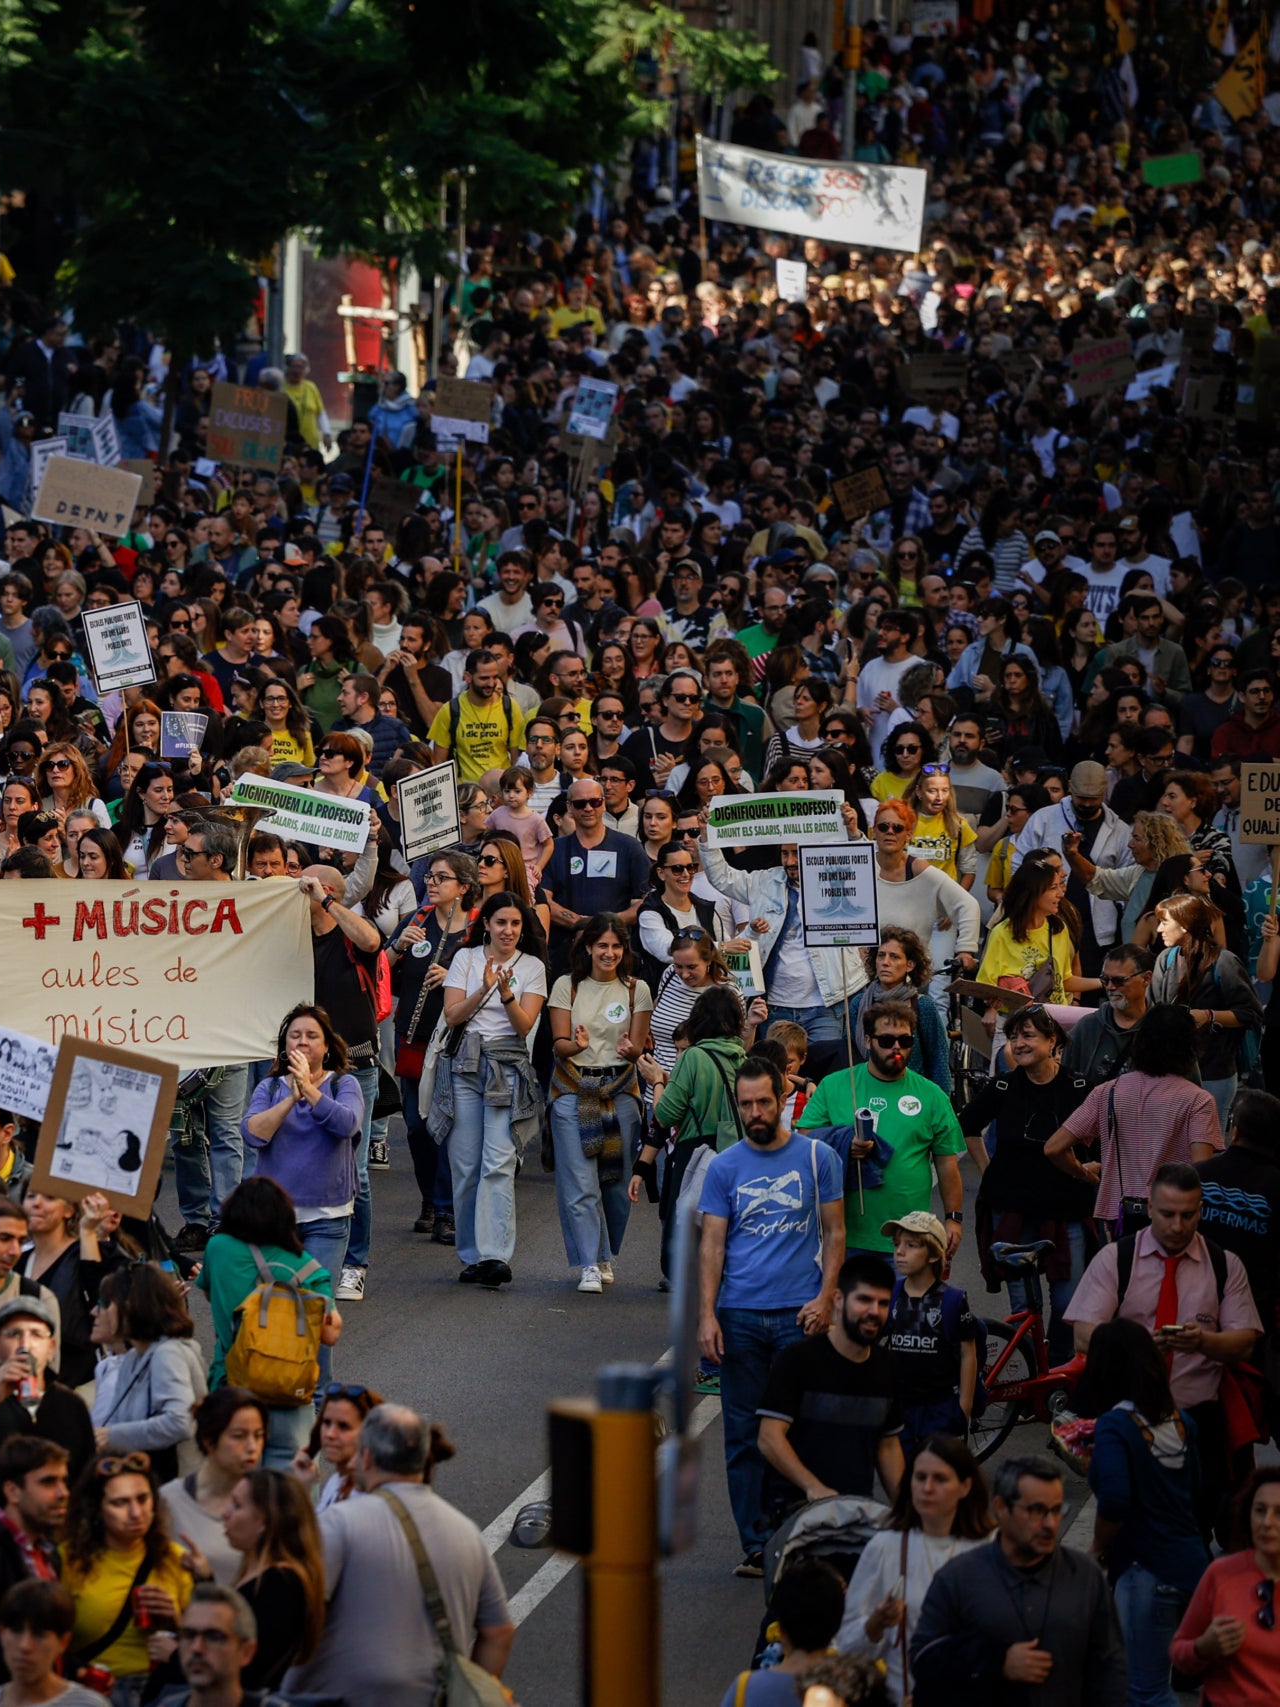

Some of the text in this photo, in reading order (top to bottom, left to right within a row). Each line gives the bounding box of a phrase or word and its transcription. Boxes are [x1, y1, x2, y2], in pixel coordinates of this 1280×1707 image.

[747, 160, 864, 191] RECURSOS
[274, 738, 292, 747] turo
[466, 729, 478, 738] dic
[237, 783, 365, 826] DIGNIFIQUEM LA PROFESSIÓ
[714, 797, 837, 821] DIGNIFIQUEM LA PROFESSIÓ
[1265, 798, 1280, 812] DE
[270, 815, 299, 832] SALARIS,
[299, 823, 320, 836] AVALL
[321, 826, 334, 838] LES
[717, 827, 741, 839] AMUNT
[742, 825, 753, 837] ELS
[755, 824, 782, 837] SALARIS,
[783, 823, 802, 835] AVALL
[803, 822, 814, 834] LES
[806, 856, 825, 866] ESCOLES
[851, 855, 869, 865] FORTES
[818, 871, 856, 881] PER UNS BARRIS
[825, 888, 842, 897] POBLES
[842, 887, 857, 896] UNITS
[41, 951, 198, 989] aules de
[45, 1005, 190, 1046] música
[1200, 1205, 1269, 1236] UPERMAS
